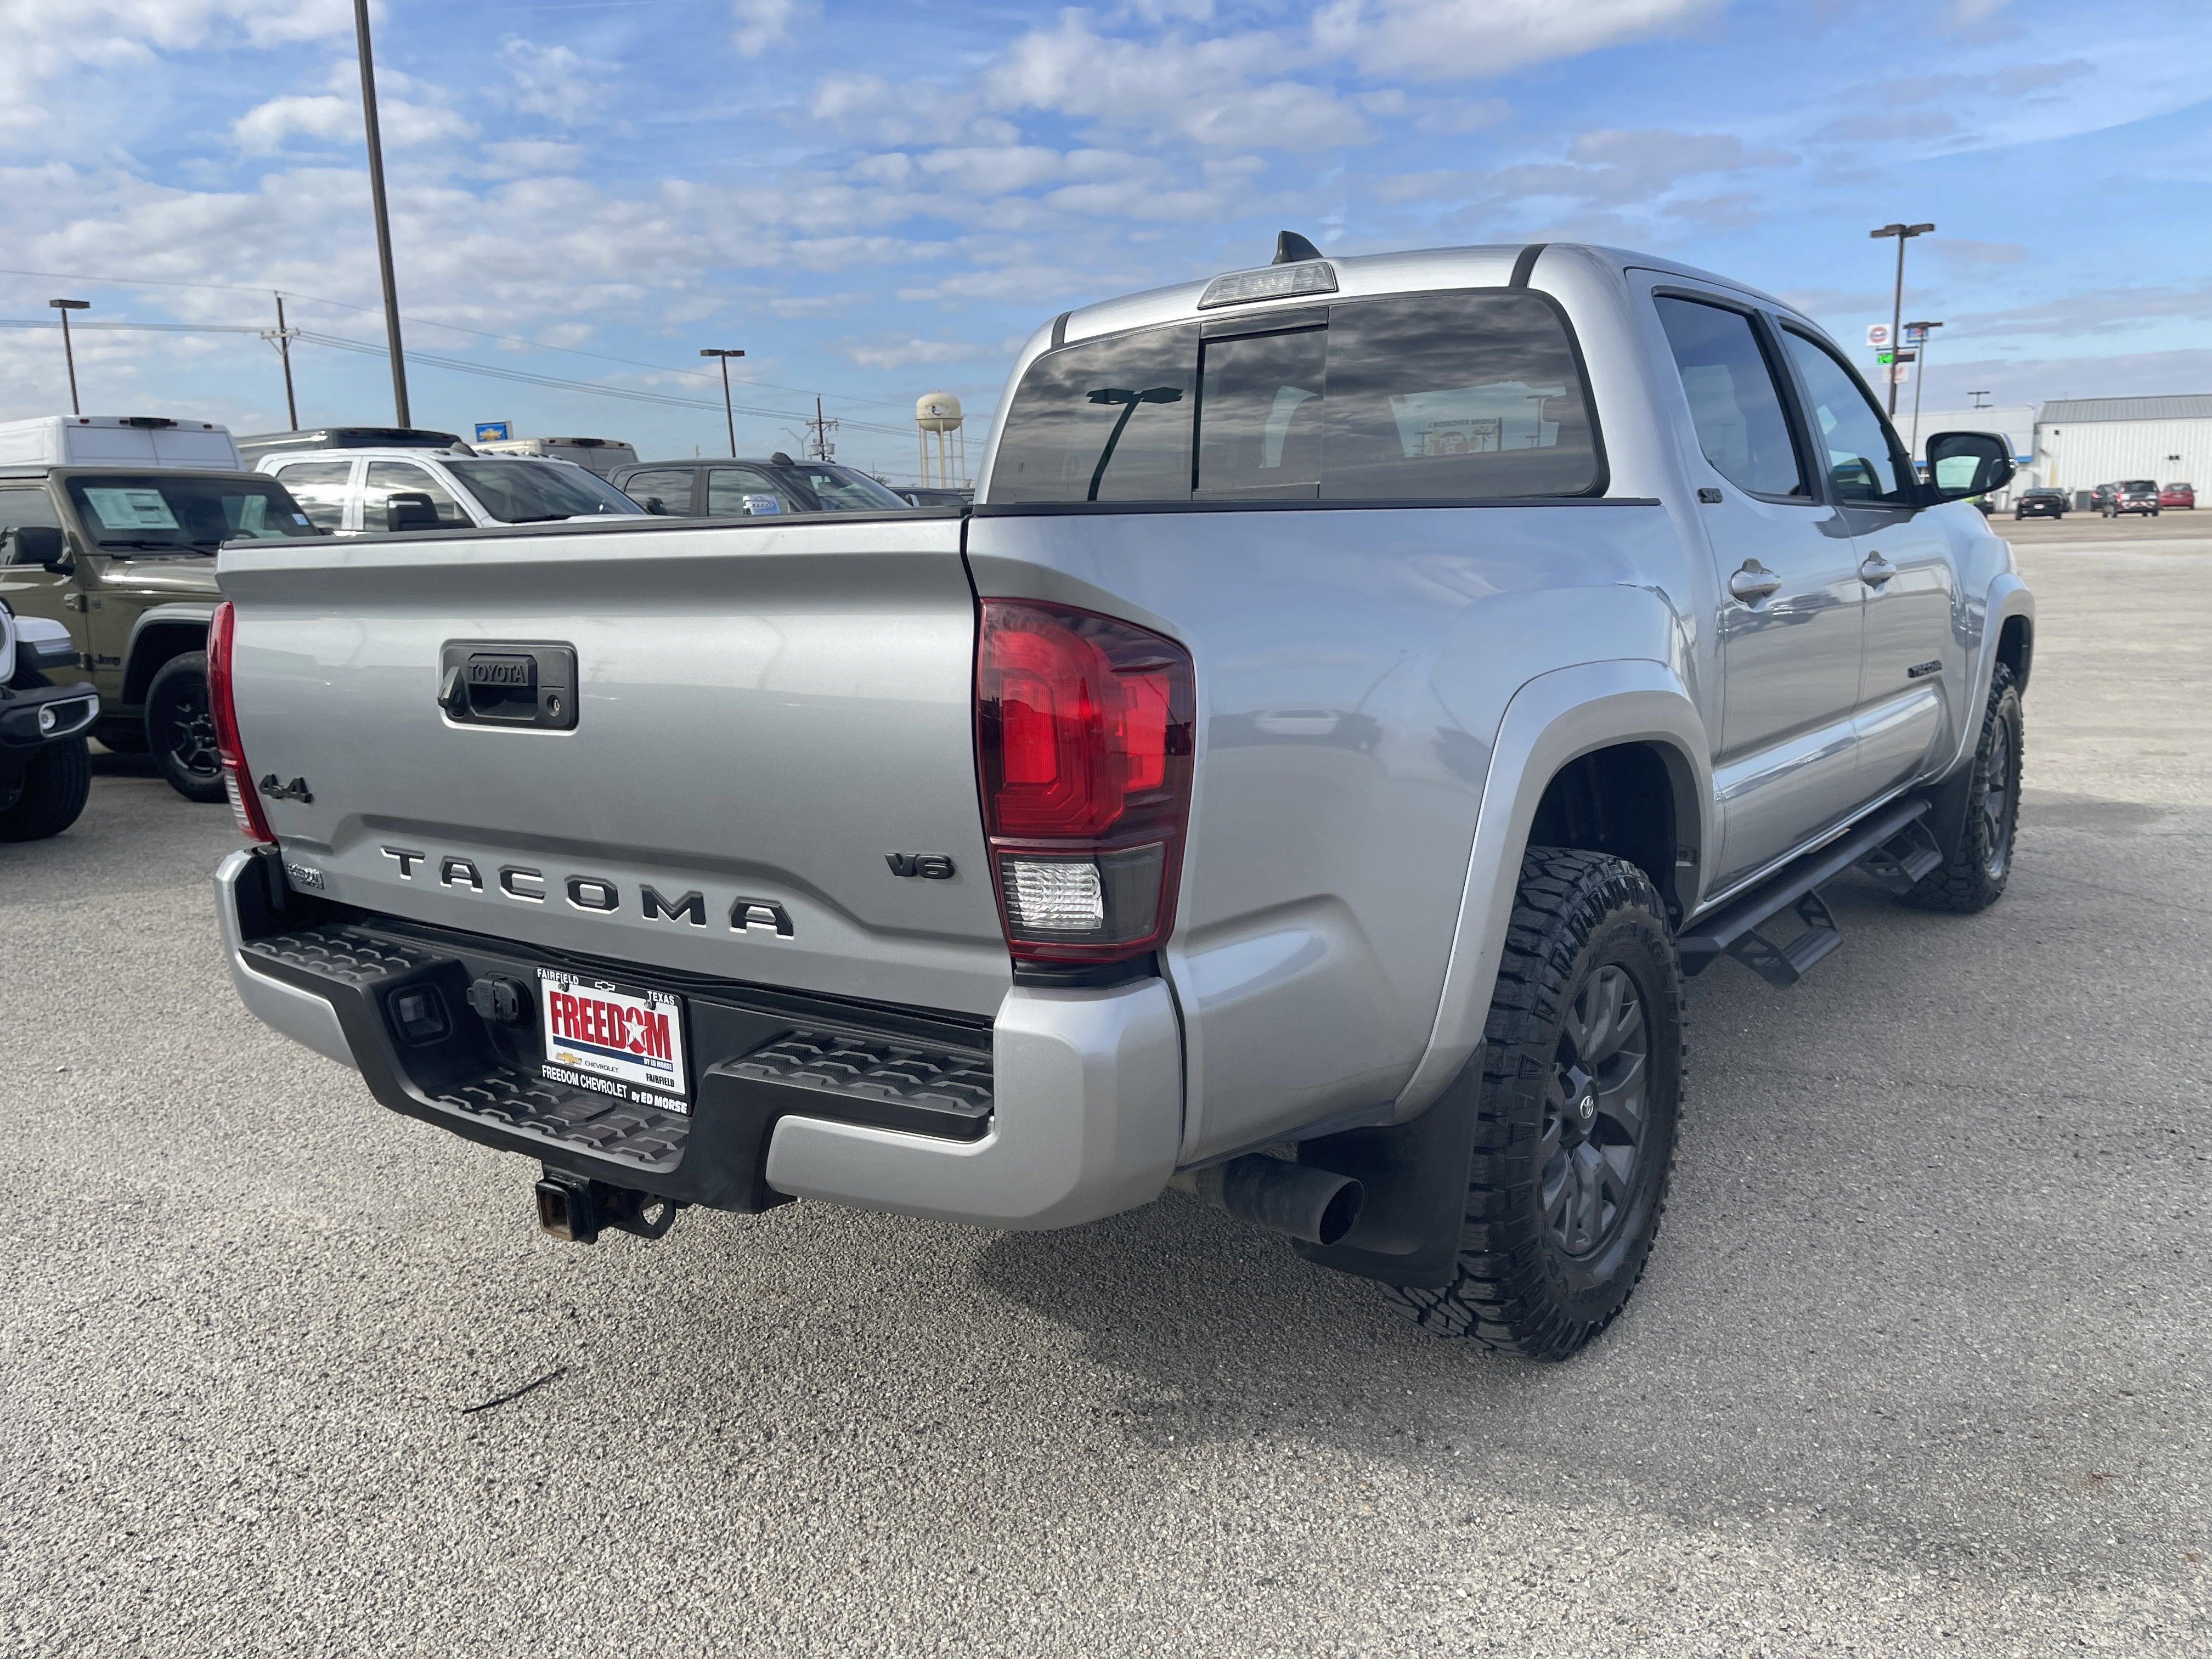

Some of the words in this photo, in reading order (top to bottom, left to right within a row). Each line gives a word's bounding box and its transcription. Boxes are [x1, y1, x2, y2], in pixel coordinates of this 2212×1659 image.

[1428, 419, 1470, 428] CROSSOVER
[469, 664, 526, 684] TOYOTA
[884, 853, 955, 879] V6
[380, 844, 794, 940] TACOMA
[537, 968, 579, 985] FAIRFIELD
[647, 991, 675, 1005] TEXAS
[549, 990, 672, 1060] FREEDOM
[585, 1060, 619, 1073] CHEVROLET
[657, 1059, 673, 1070] MORSE
[646, 1073, 674, 1087] FAIRFIELD
[541, 1065, 579, 1086] FREEDOM
[580, 1074, 627, 1098] CHEVROLET
[631, 1091, 640, 1103] By
[641, 1092, 652, 1105] ED
[654, 1095, 687, 1114] MORSE
